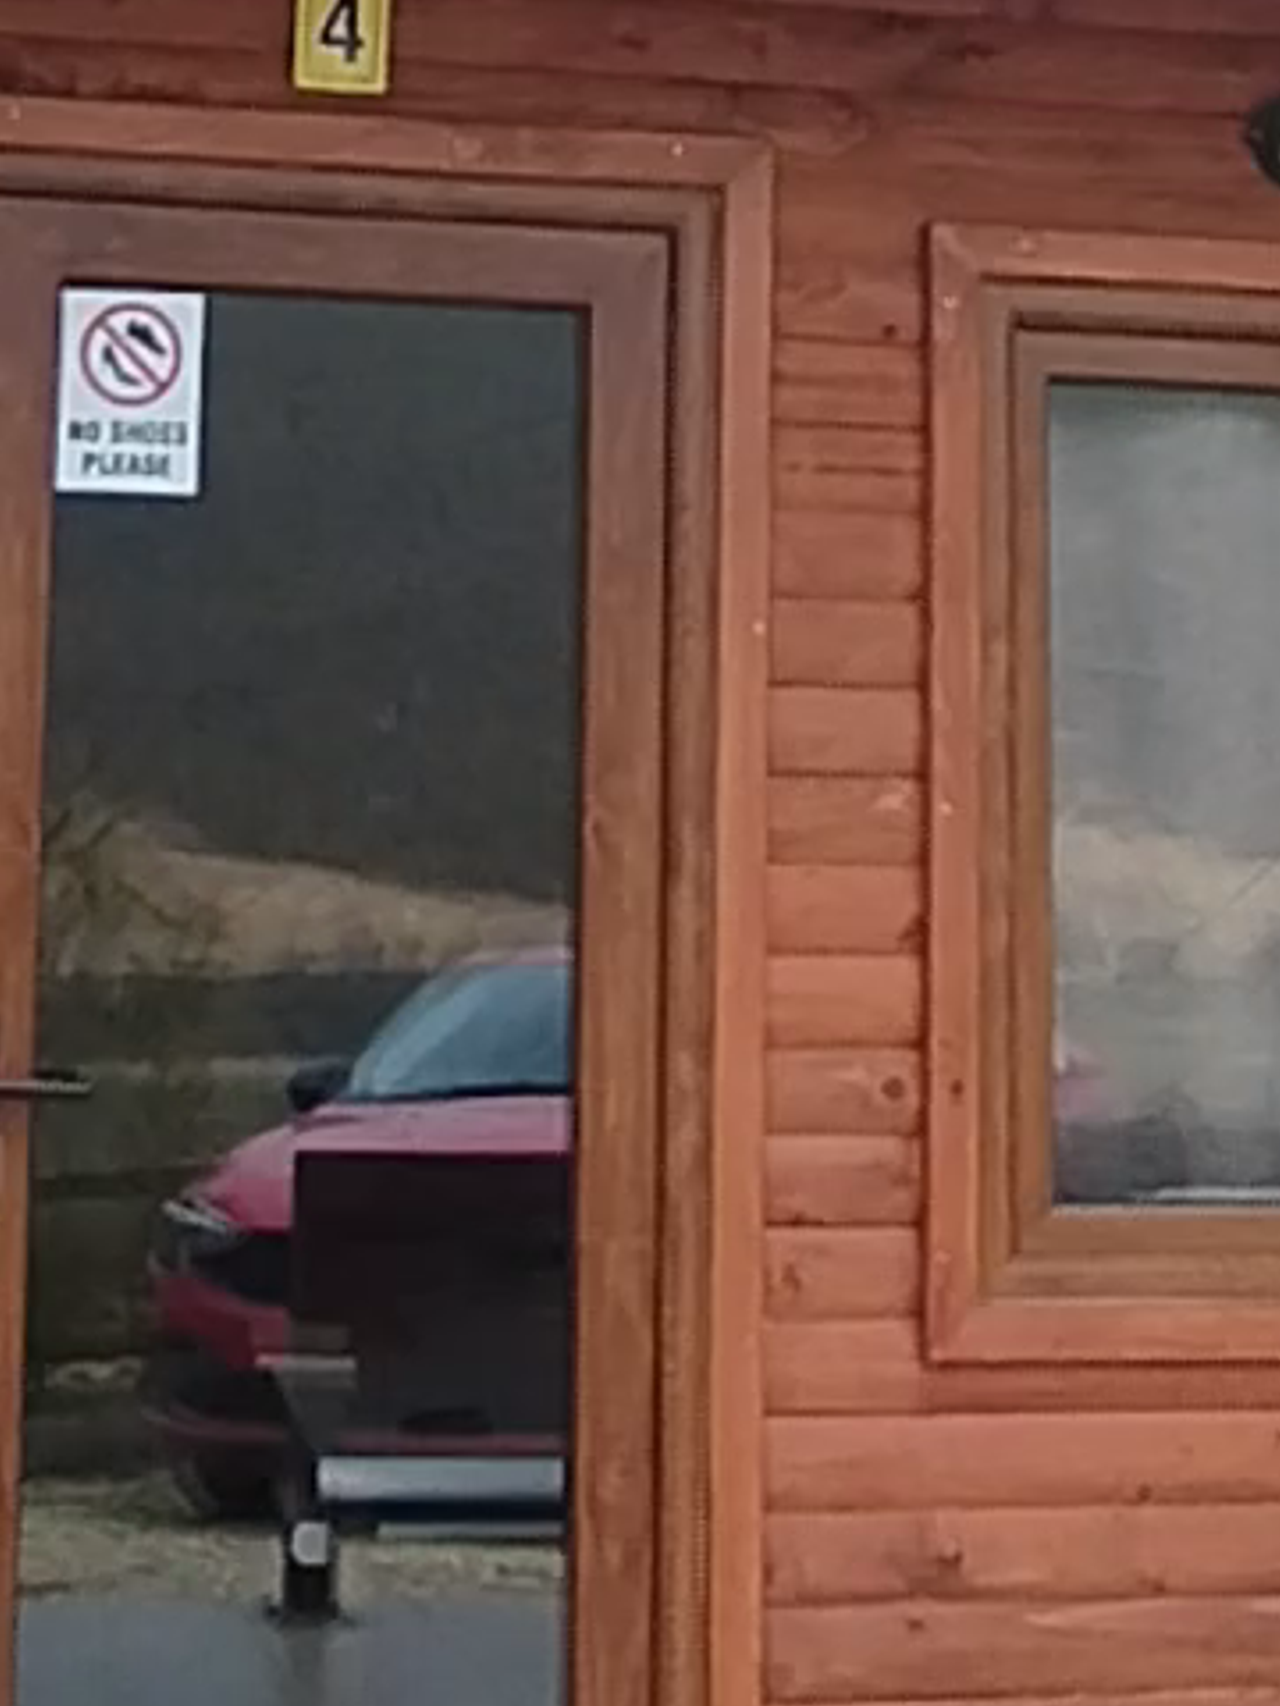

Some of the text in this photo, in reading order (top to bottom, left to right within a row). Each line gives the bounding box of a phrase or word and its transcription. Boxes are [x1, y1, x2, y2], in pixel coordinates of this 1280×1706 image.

[68, 419, 188, 446] NO SHOES
[81, 452, 171, 477] PLEASE
